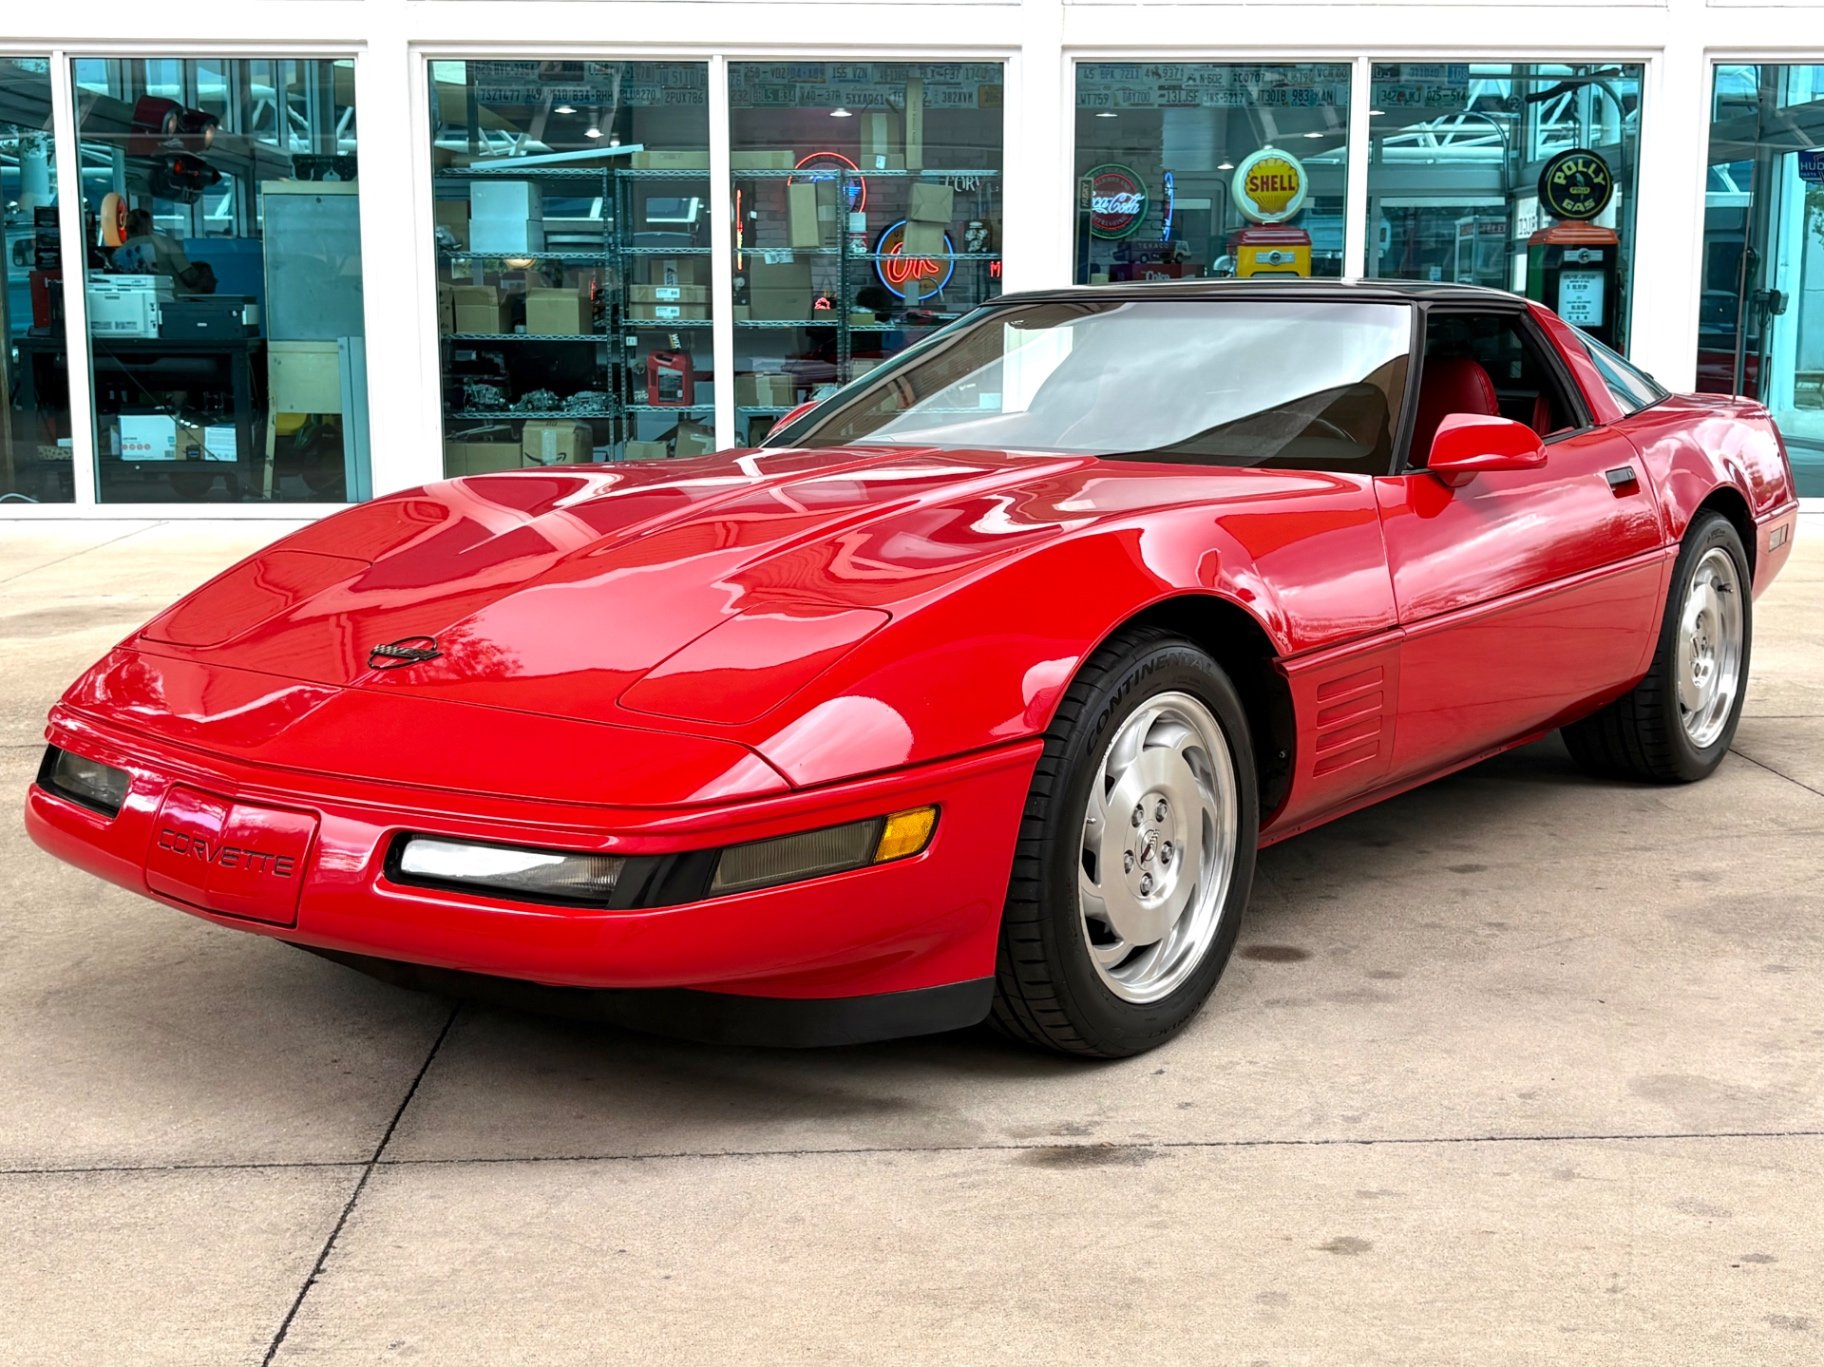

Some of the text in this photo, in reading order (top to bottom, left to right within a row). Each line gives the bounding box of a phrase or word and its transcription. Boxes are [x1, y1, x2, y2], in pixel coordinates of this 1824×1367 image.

[1249, 174, 1296, 193] SHELL
[1554, 159, 1606, 186] POLLY
[1561, 198, 1596, 212] GAS
[1086, 651, 1214, 758] CONTINENTAL
[157, 828, 296, 878] CORVETTE
